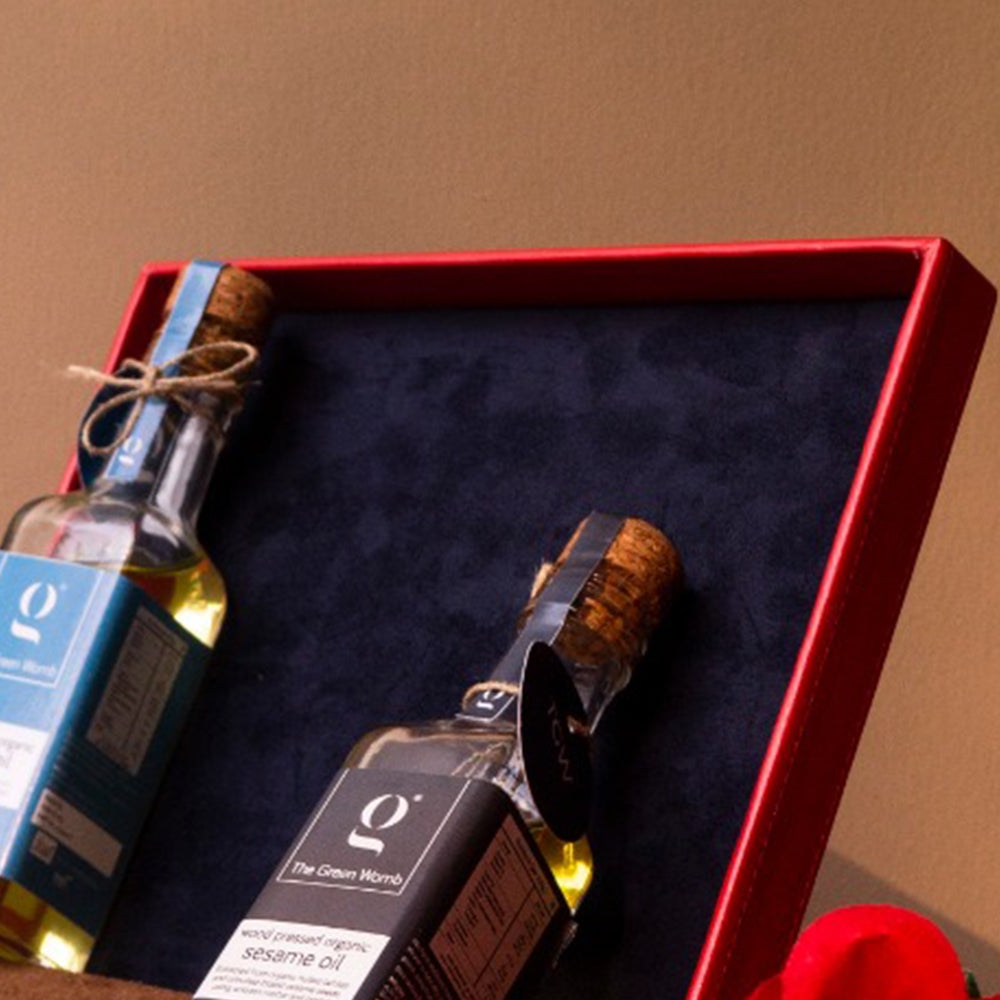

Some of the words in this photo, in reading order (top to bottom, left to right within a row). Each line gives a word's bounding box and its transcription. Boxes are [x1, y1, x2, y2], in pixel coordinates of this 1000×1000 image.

[22, 658, 58, 677] Womb
[291, 861, 315, 876] The
[316, 864, 357, 880] Green
[359, 868, 404, 885] Womb
[241, 929, 273, 941] wood
[272, 931, 325, 947] pressed
[323, 938, 371, 954] organic
[241, 947, 316, 967] sesame
[318, 953, 346, 971] oil
